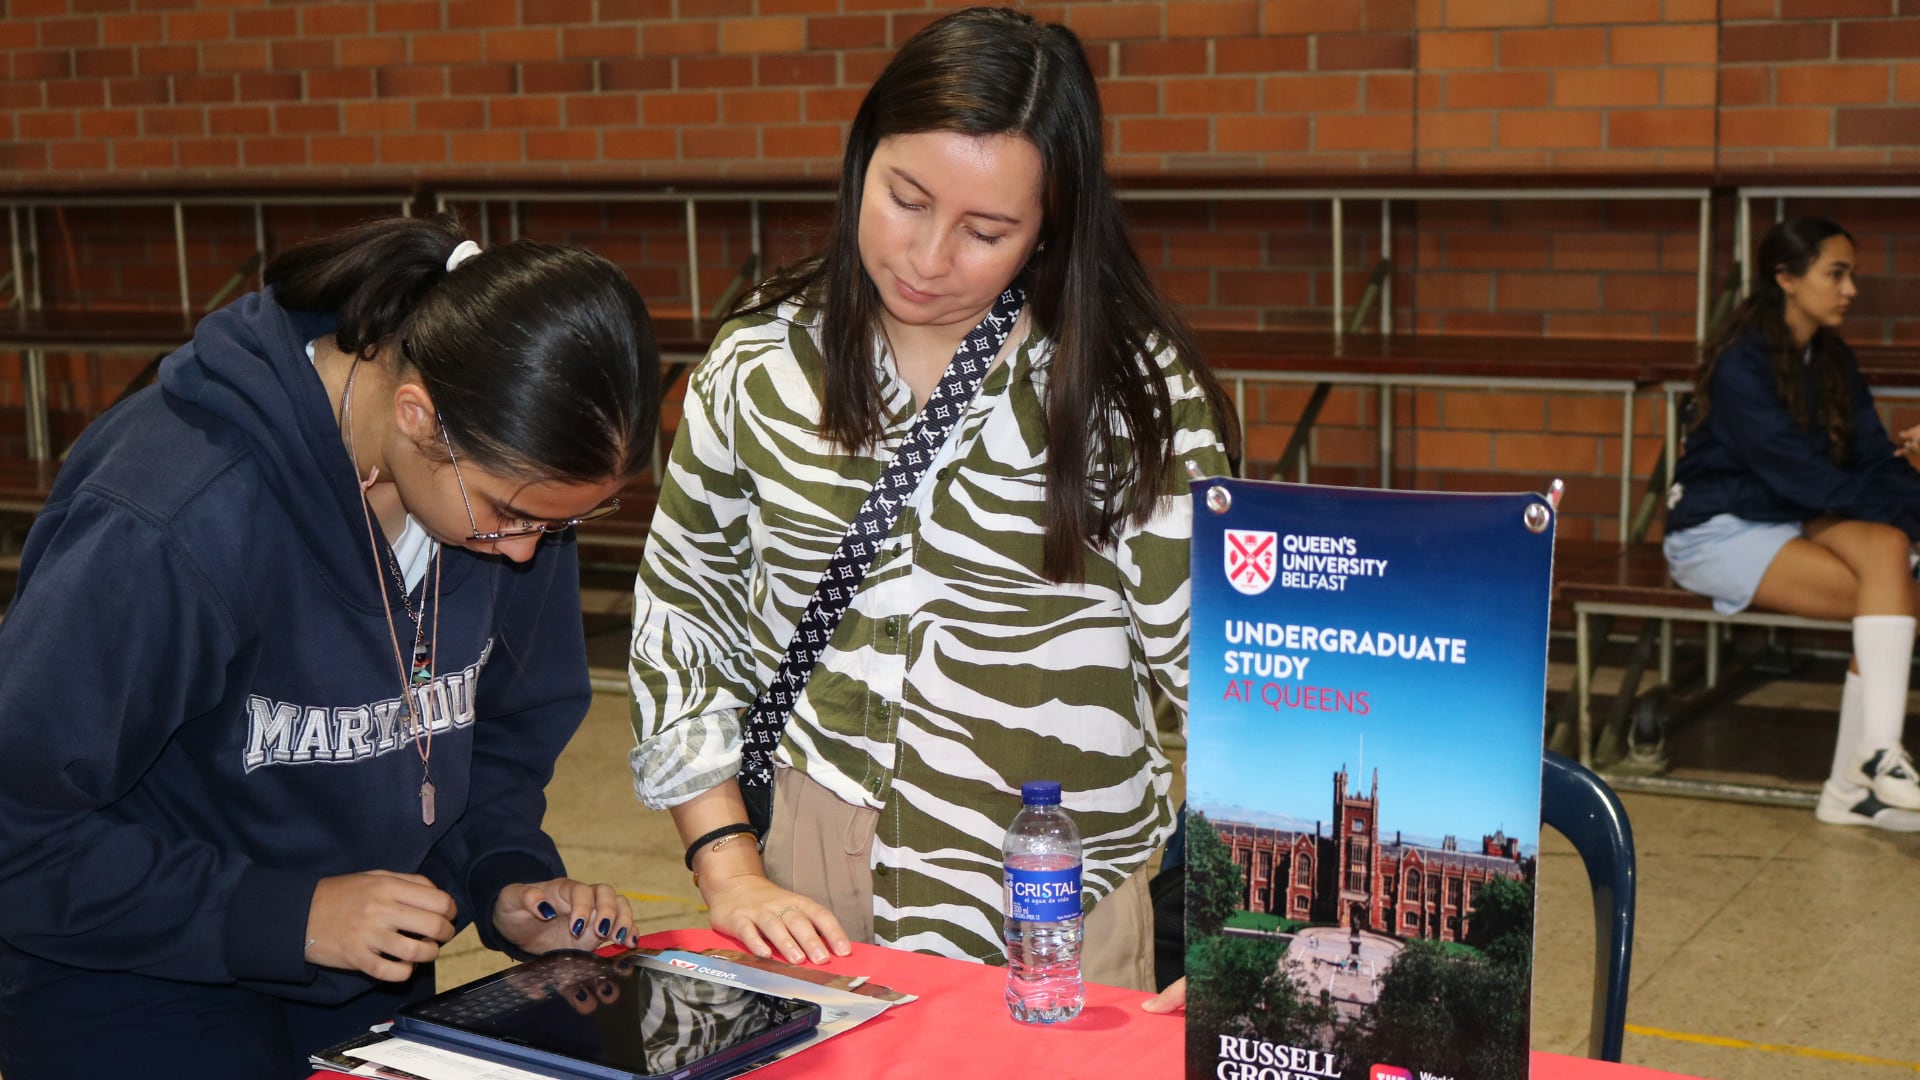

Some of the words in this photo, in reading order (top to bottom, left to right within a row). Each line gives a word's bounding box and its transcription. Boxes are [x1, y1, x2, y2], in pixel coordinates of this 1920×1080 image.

[1283, 535, 1356, 555] QUEEN'S
[1282, 554, 1388, 577] UNIVERSITY
[1281, 574, 1347, 591] BELFAST
[1225, 620, 1466, 664] UNDERGRADUATE
[1223, 650, 1310, 681] STUDY
[1223, 680, 1255, 702] AT
[1261, 683, 1370, 716] QUEENS
[1015, 881, 1077, 898] CRISTAL
[1218, 1034, 1342, 1078] RUSSELL
[1216, 1060, 1320, 1080] GRO
